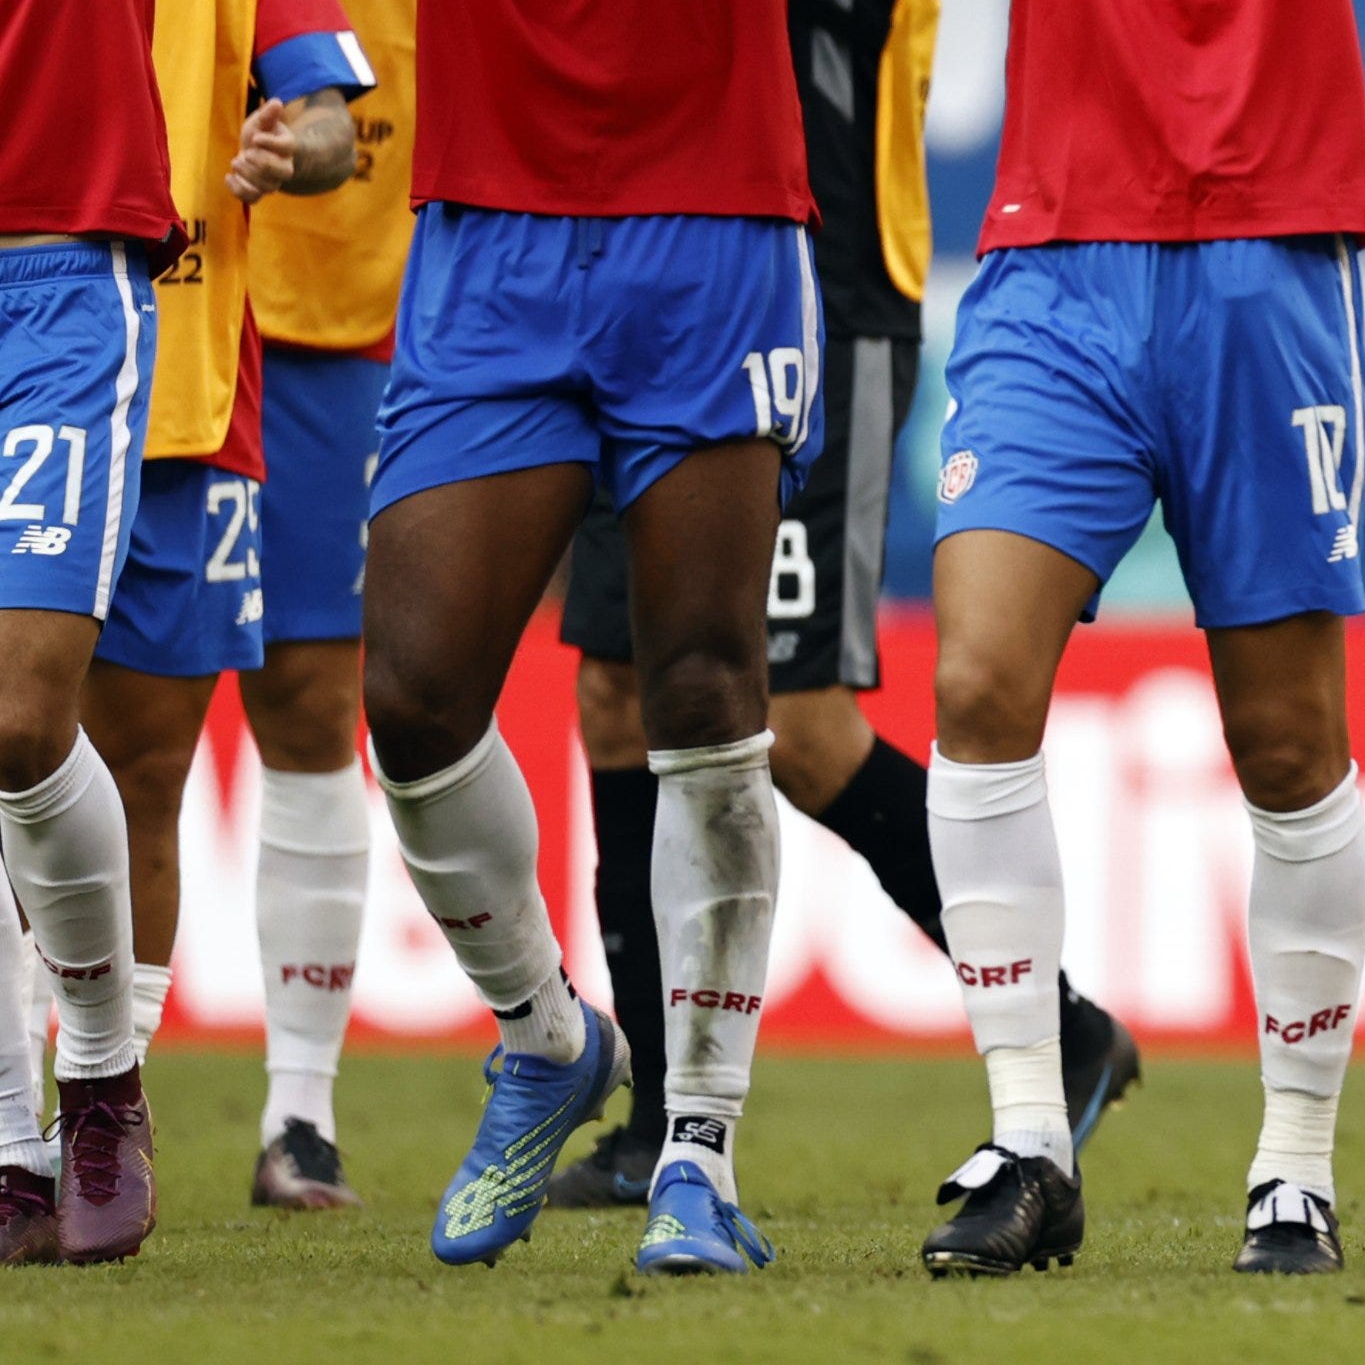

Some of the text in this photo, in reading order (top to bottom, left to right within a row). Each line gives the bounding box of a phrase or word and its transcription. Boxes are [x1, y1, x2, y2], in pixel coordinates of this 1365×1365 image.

[741, 347, 804, 445] 19
[0, 424, 87, 526] 21
[281, 960, 356, 992] FCR
[670, 988, 762, 1015] FCRF
[1265, 1004, 1352, 1045] FCRF
